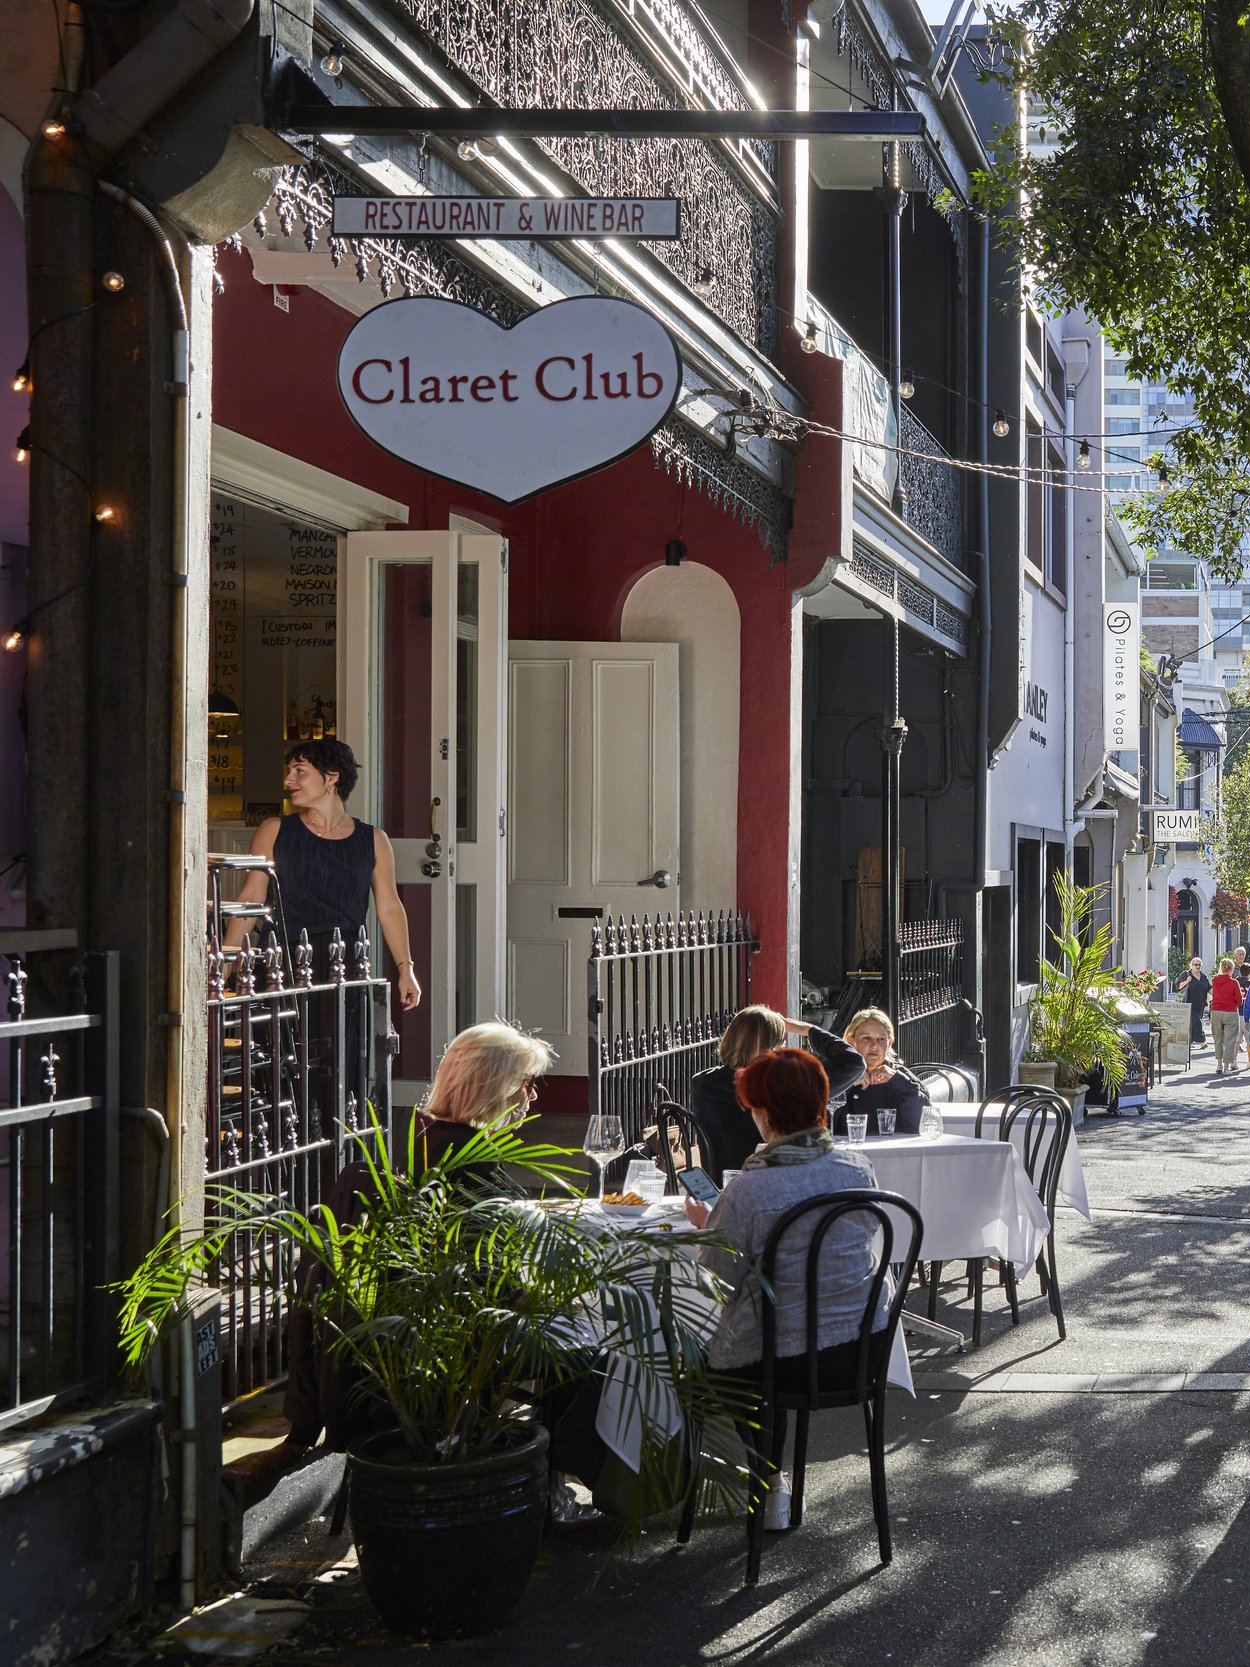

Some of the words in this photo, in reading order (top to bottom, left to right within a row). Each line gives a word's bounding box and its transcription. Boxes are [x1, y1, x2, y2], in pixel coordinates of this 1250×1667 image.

[365, 201, 505, 231] RESTAURANT
[519, 203, 533, 231] &
[352, 357, 519, 405] Claret
[535, 353, 664, 401] Club
[1115, 638, 1126, 686] Pilates
[1024, 681, 1048, 724] ANLEY
[1115, 692, 1126, 701] &
[1113, 708, 1126, 745] Yoga
[1157, 815, 1197, 829] RUMI
[1157, 830, 1171, 838] THE
